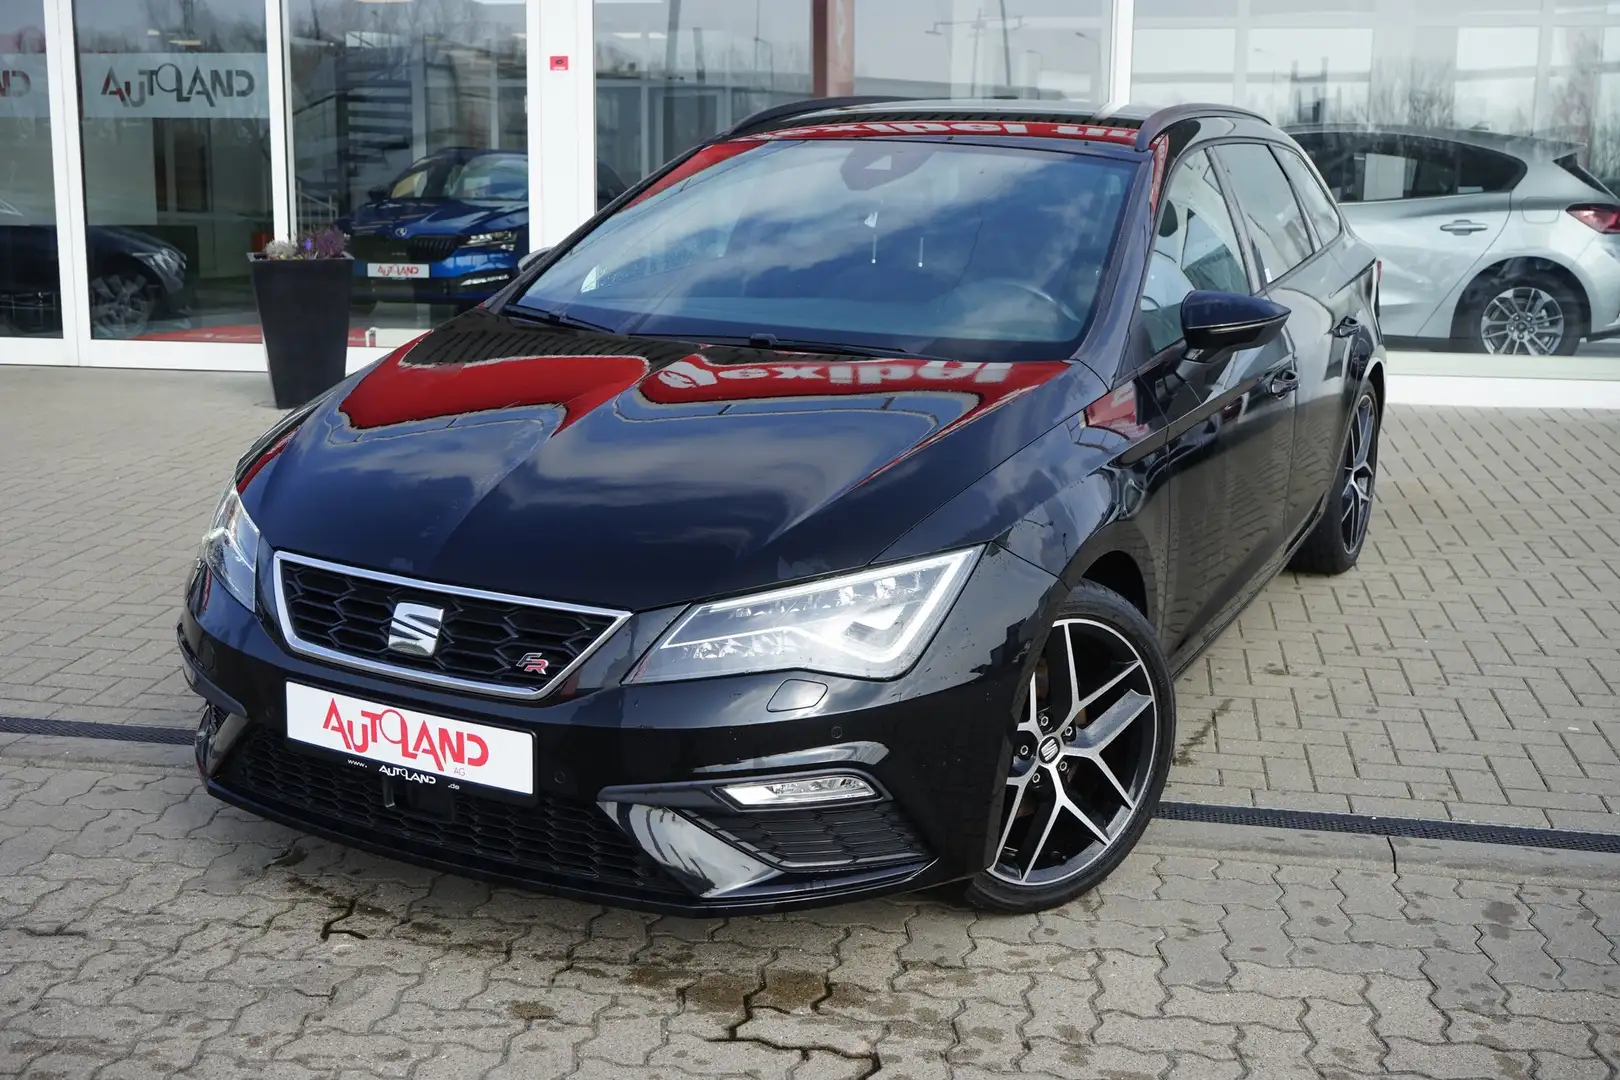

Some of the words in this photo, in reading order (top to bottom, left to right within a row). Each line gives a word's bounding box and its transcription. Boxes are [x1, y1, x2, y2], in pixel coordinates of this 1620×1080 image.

[100, 63, 255, 107] AUTOLAND
[516, 653, 549, 675] FR
[323, 697, 489, 772] AUTOLAND
[379, 764, 436, 784] AUTOLAND
[453, 767, 466, 777] AG
